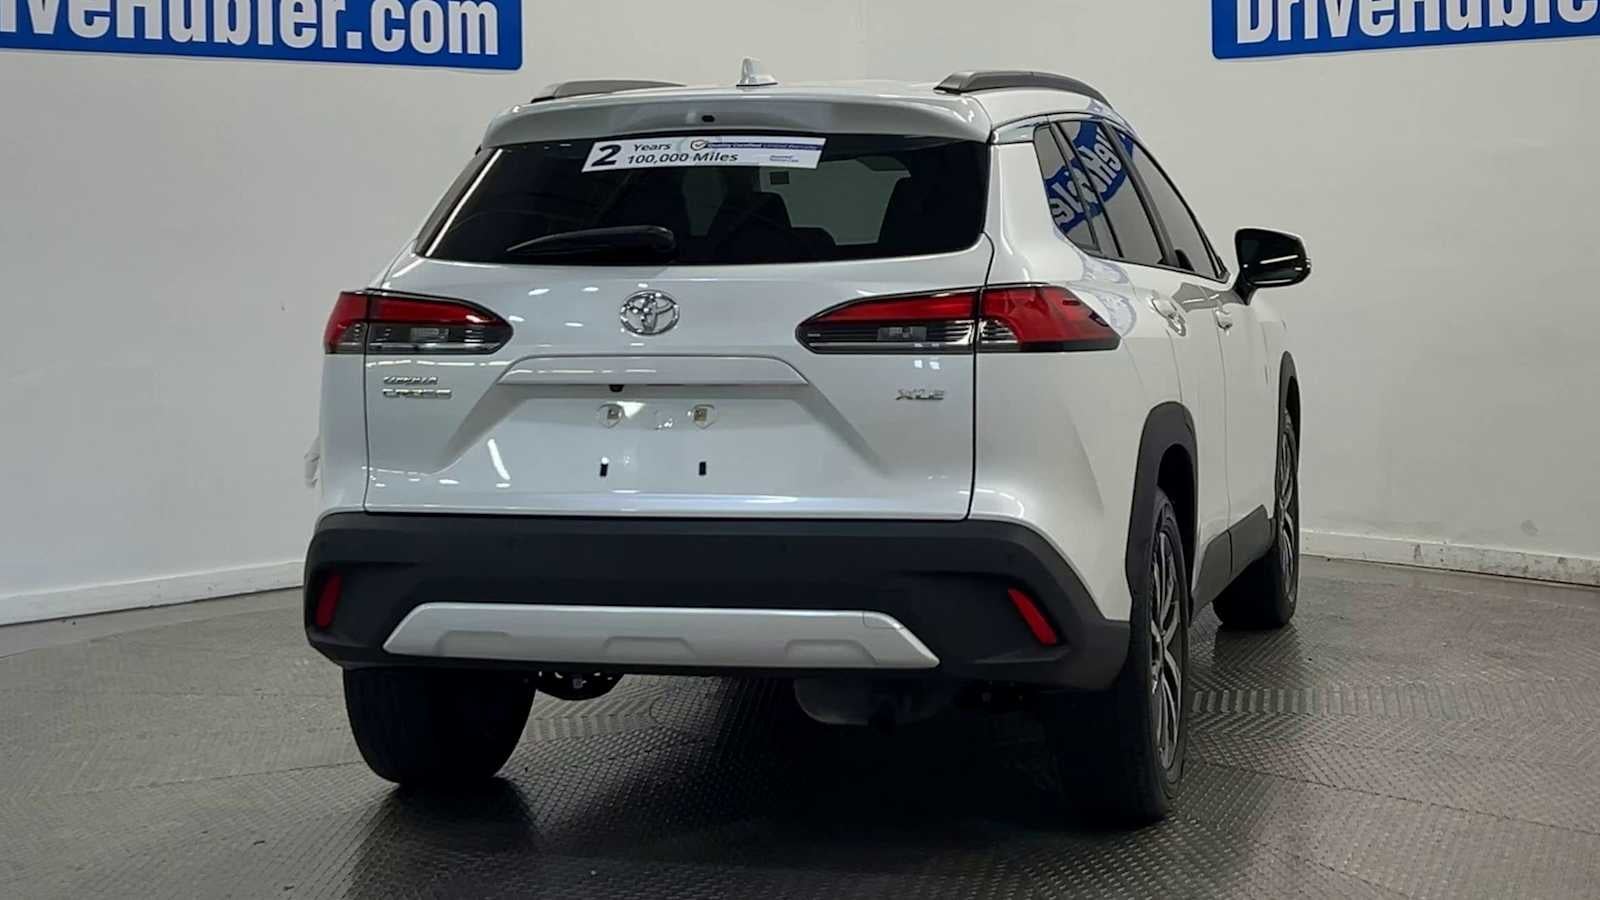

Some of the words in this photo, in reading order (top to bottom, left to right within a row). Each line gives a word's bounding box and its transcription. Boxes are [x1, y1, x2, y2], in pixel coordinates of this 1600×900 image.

[633, 143, 672, 153] Years
[591, 144, 622, 167] 2
[627, 153, 689, 164] 100,000
[693, 152, 739, 162] Miles
